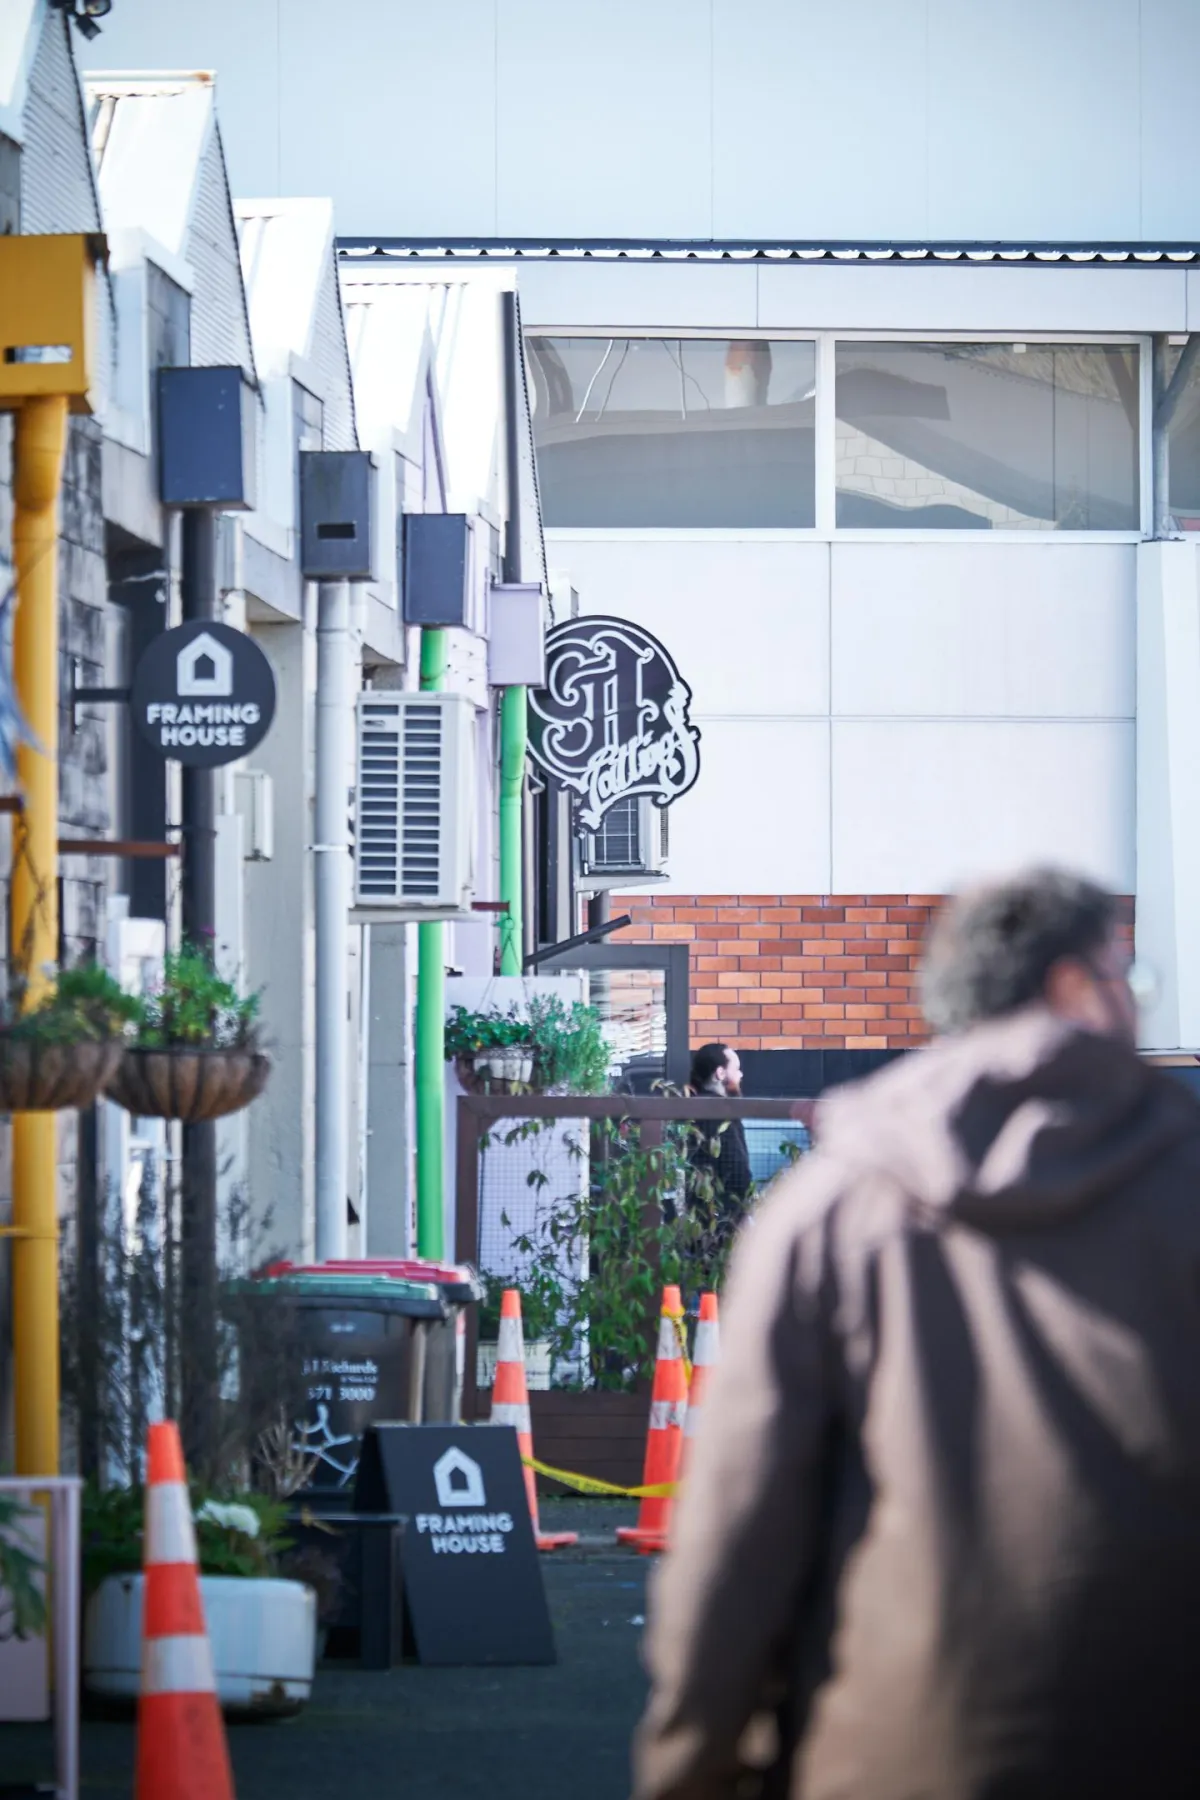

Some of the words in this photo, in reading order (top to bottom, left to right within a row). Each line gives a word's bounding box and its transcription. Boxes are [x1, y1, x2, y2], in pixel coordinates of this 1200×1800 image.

[147, 703, 261, 725] FRAMING
[161, 725, 246, 747] HOUSE
[415, 1512, 514, 1534] FRAMING
[431, 1534, 505, 1554] HOUSE
